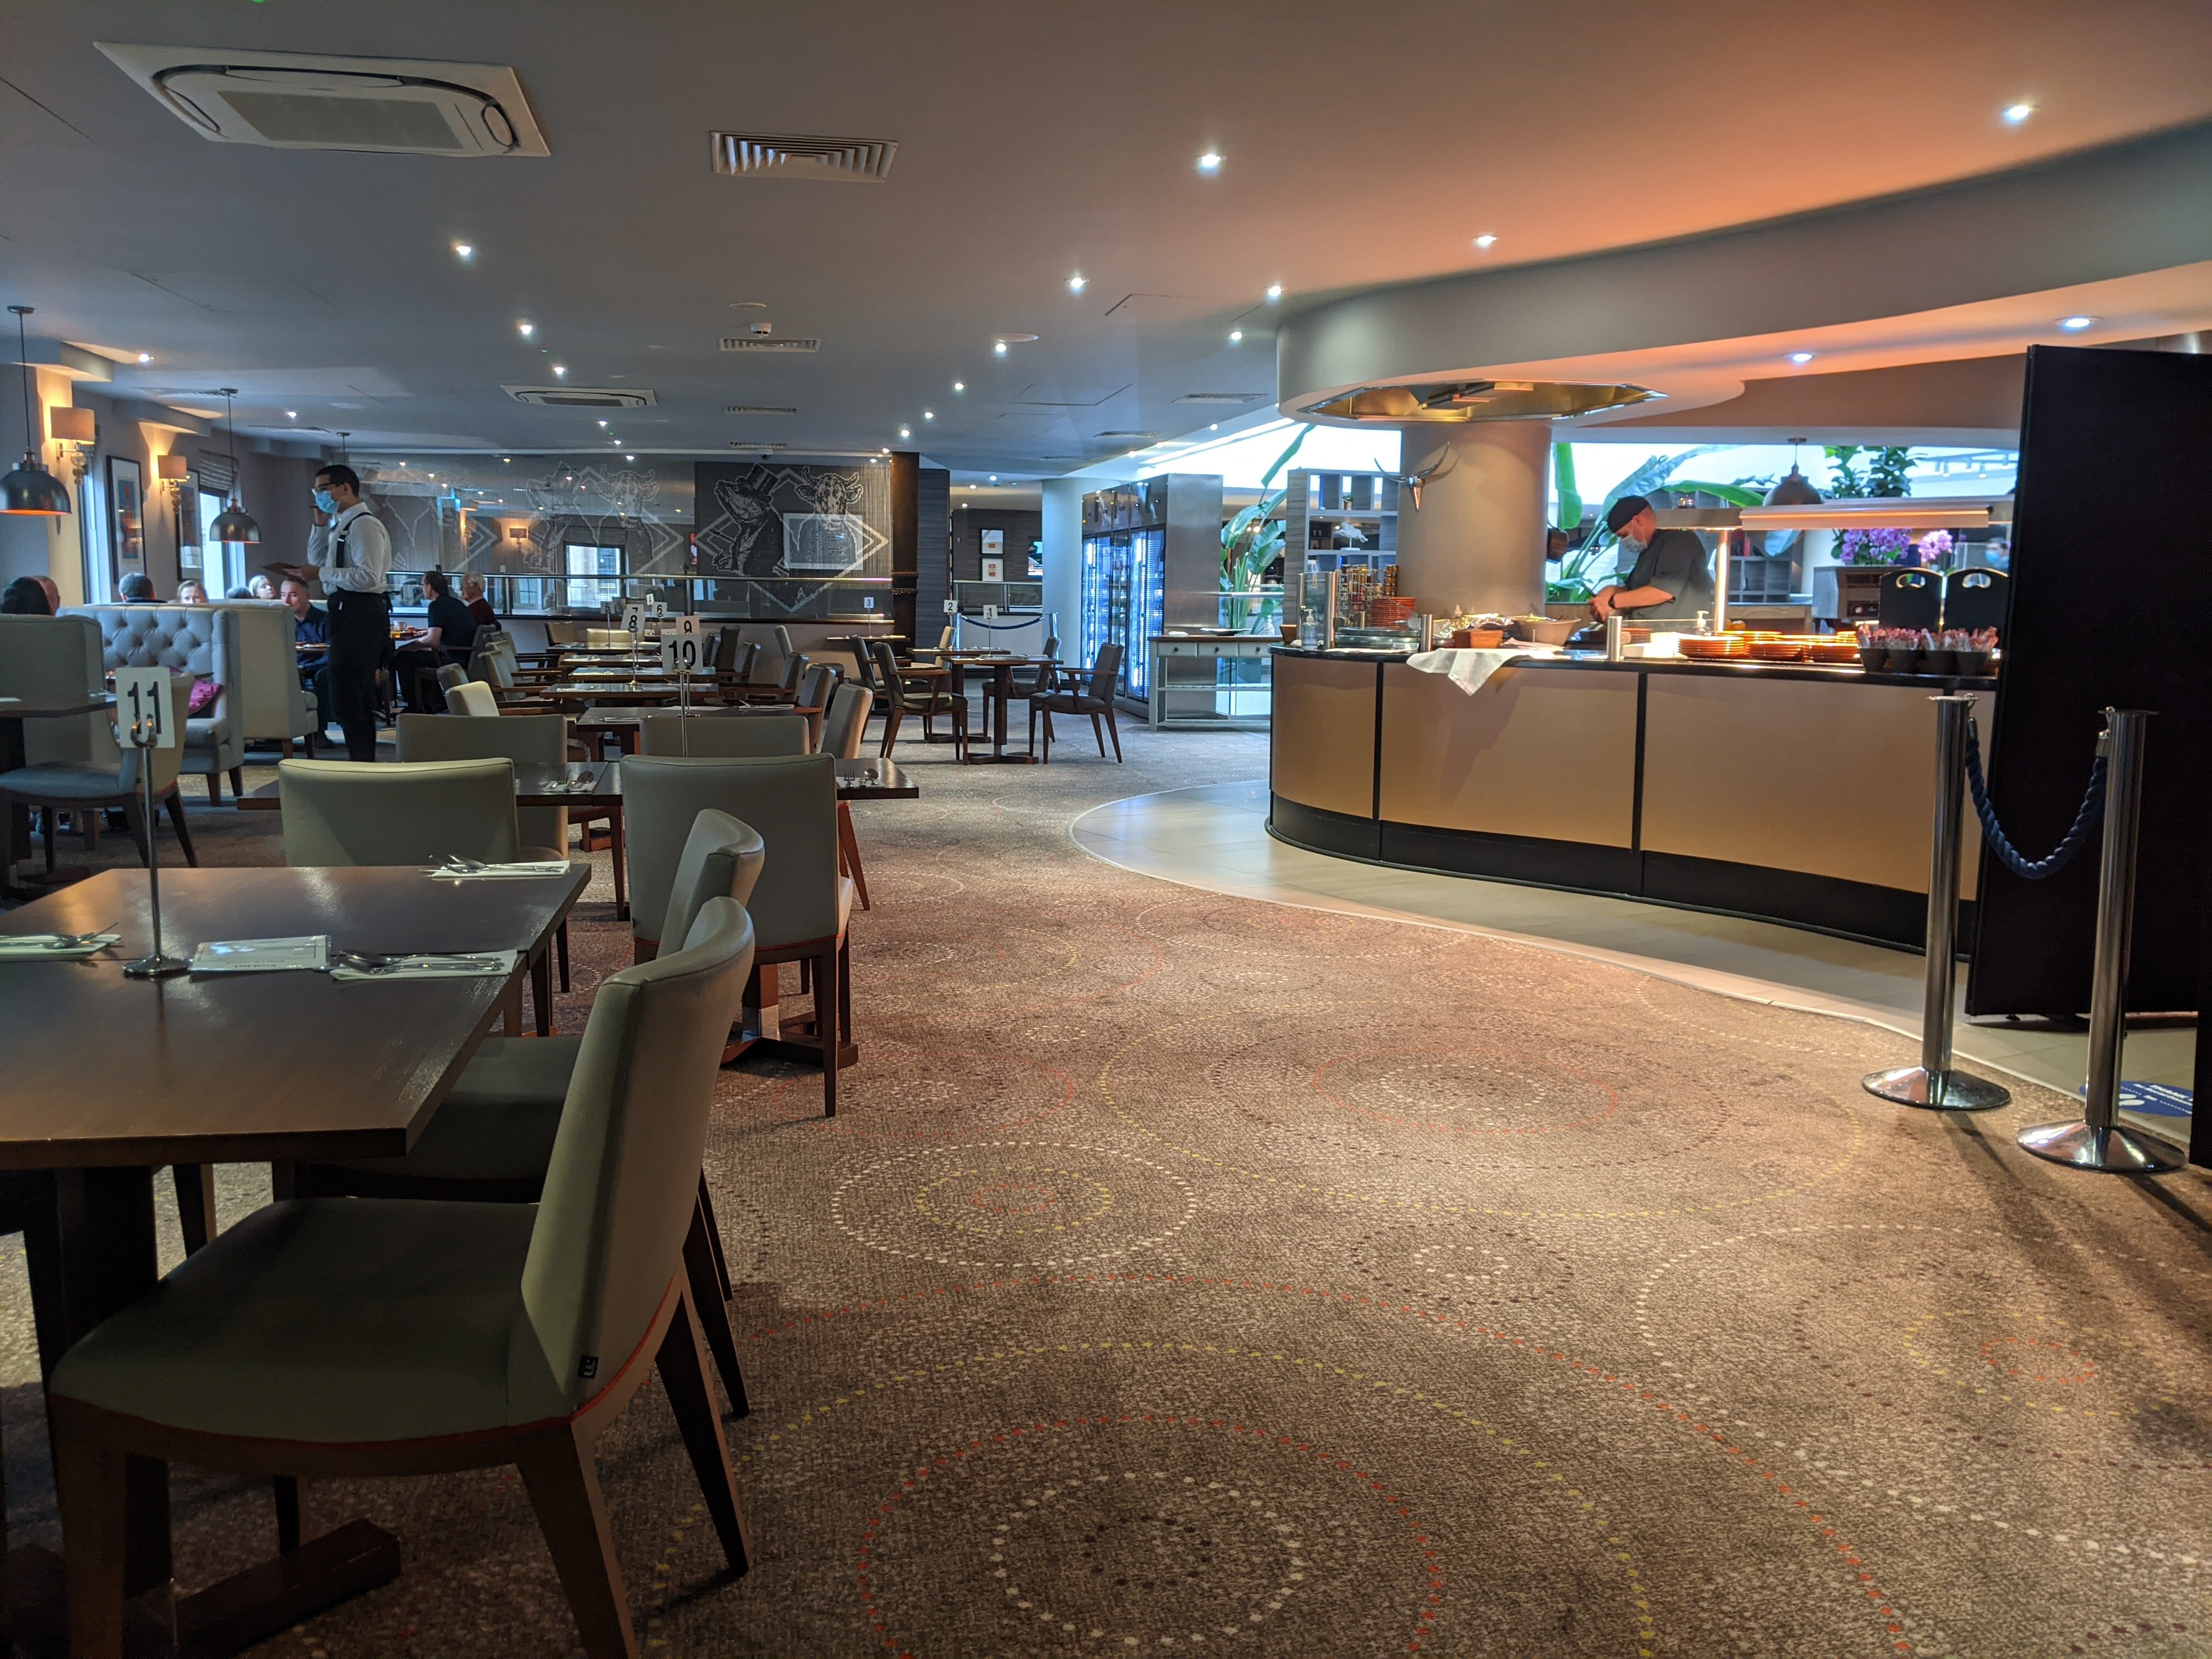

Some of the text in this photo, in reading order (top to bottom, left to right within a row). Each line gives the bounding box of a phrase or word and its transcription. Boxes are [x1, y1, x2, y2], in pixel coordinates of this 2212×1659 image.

[657, 605, 663, 615] 6
[948, 602, 953, 611] 2
[988, 607, 992, 617] 1
[629, 615, 637, 629] 8
[684, 620, 692, 634] 9
[668, 640, 696, 668] 10
[127, 681, 162, 735] 11
